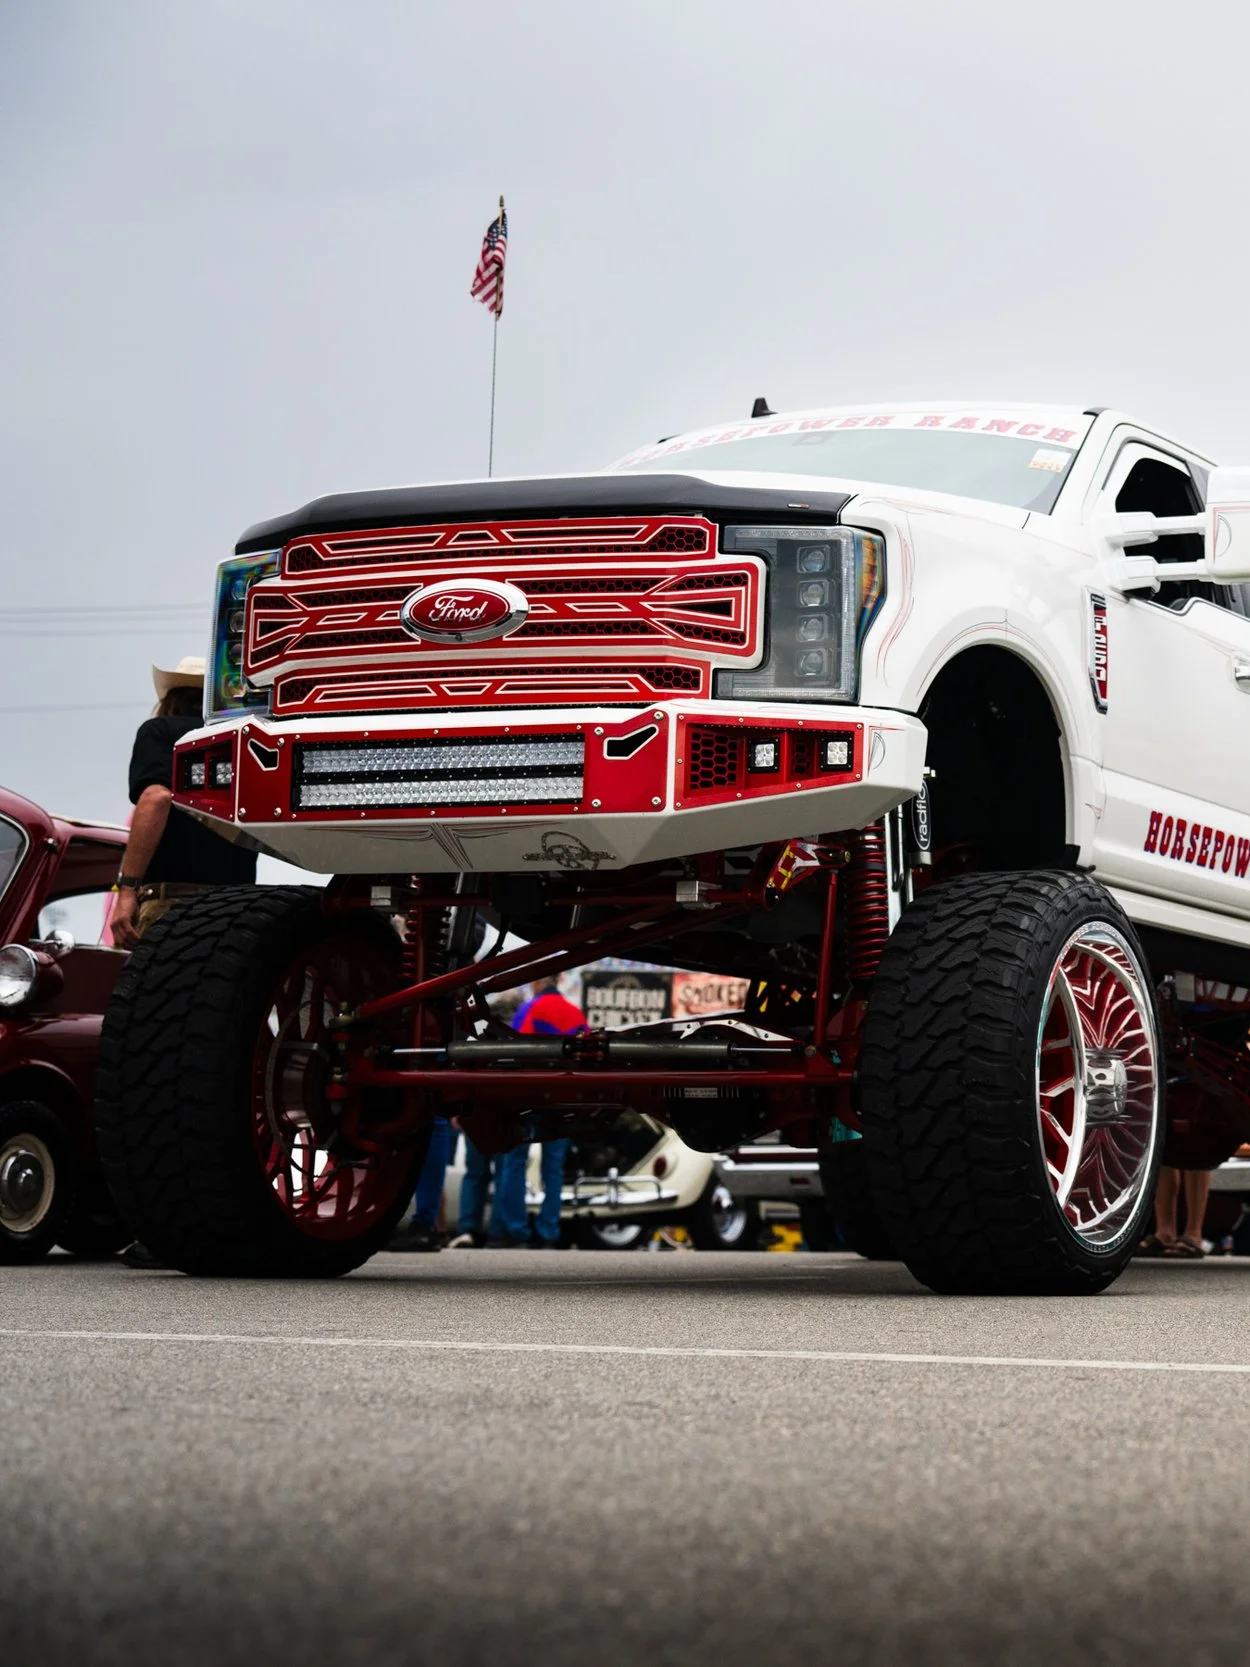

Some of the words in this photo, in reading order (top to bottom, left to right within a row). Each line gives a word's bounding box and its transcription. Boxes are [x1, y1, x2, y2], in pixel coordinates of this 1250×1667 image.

[913, 415, 1077, 442] RANCH
[428, 595, 489, 622] Ford
[916, 785, 928, 842] radflo
